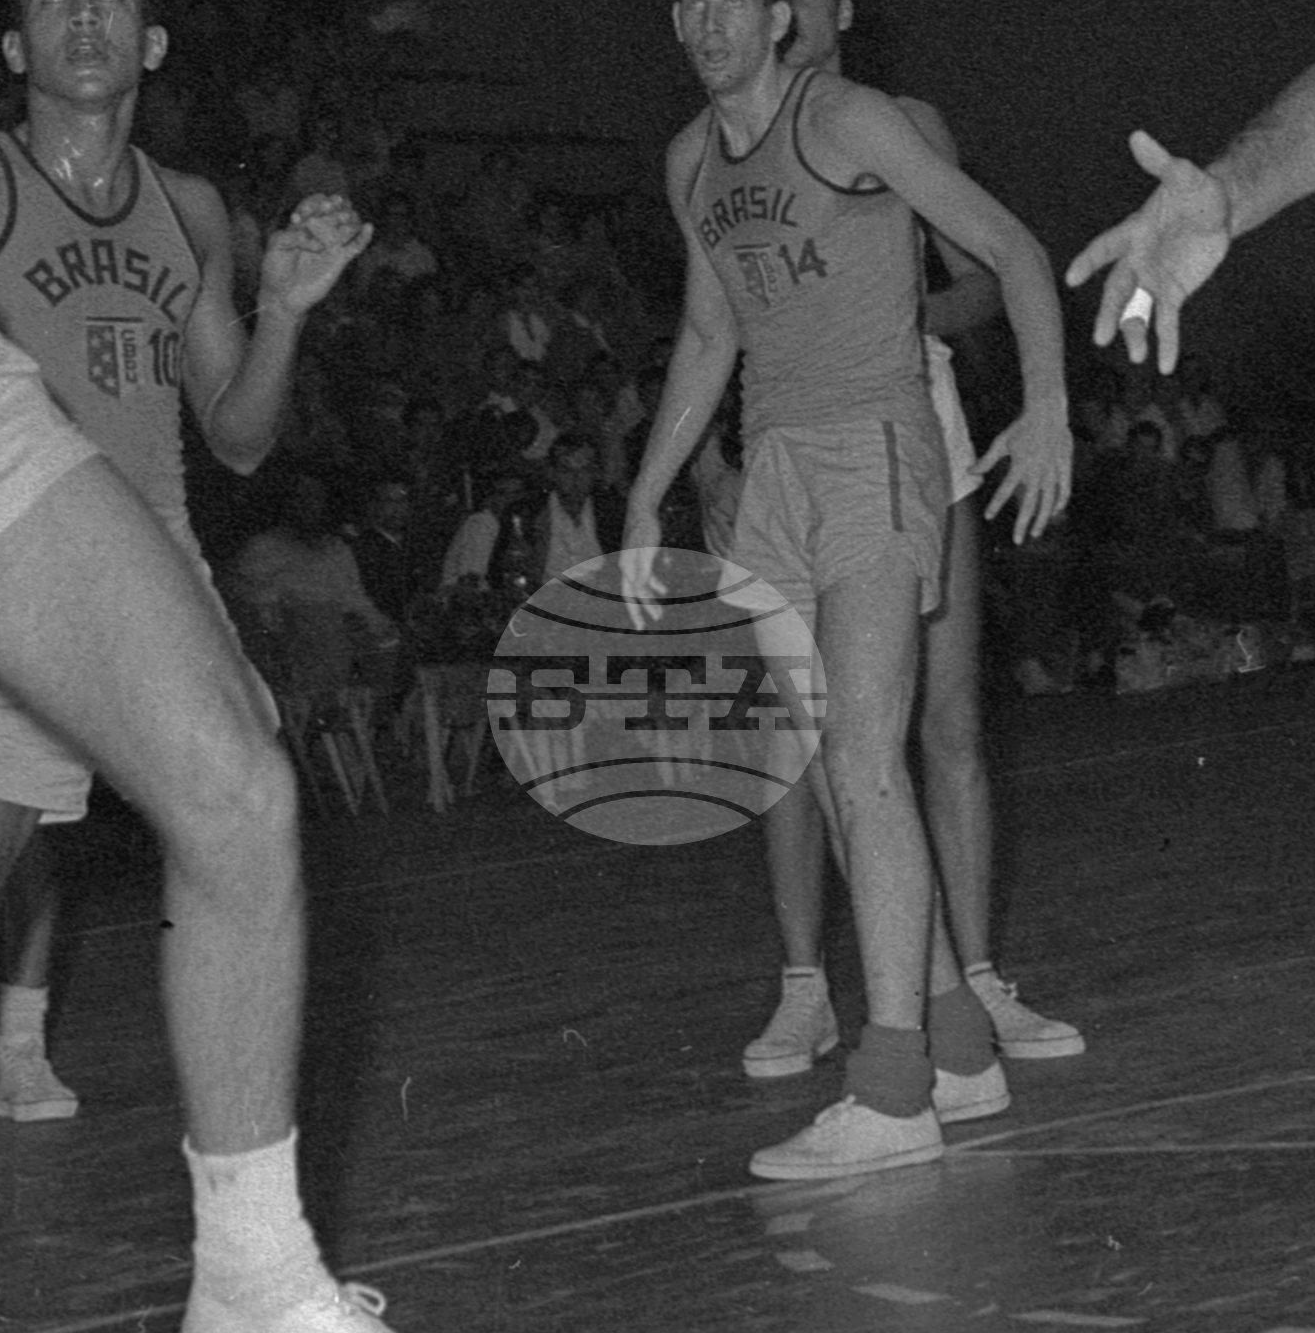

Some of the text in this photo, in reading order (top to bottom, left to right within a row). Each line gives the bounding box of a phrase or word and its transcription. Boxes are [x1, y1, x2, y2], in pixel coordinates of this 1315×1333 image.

[700, 185, 799, 249] BRASIL
[22, 238, 187, 324] BRASIL
[777, 237, 829, 285] 14
[147, 327, 181, 387] 10
